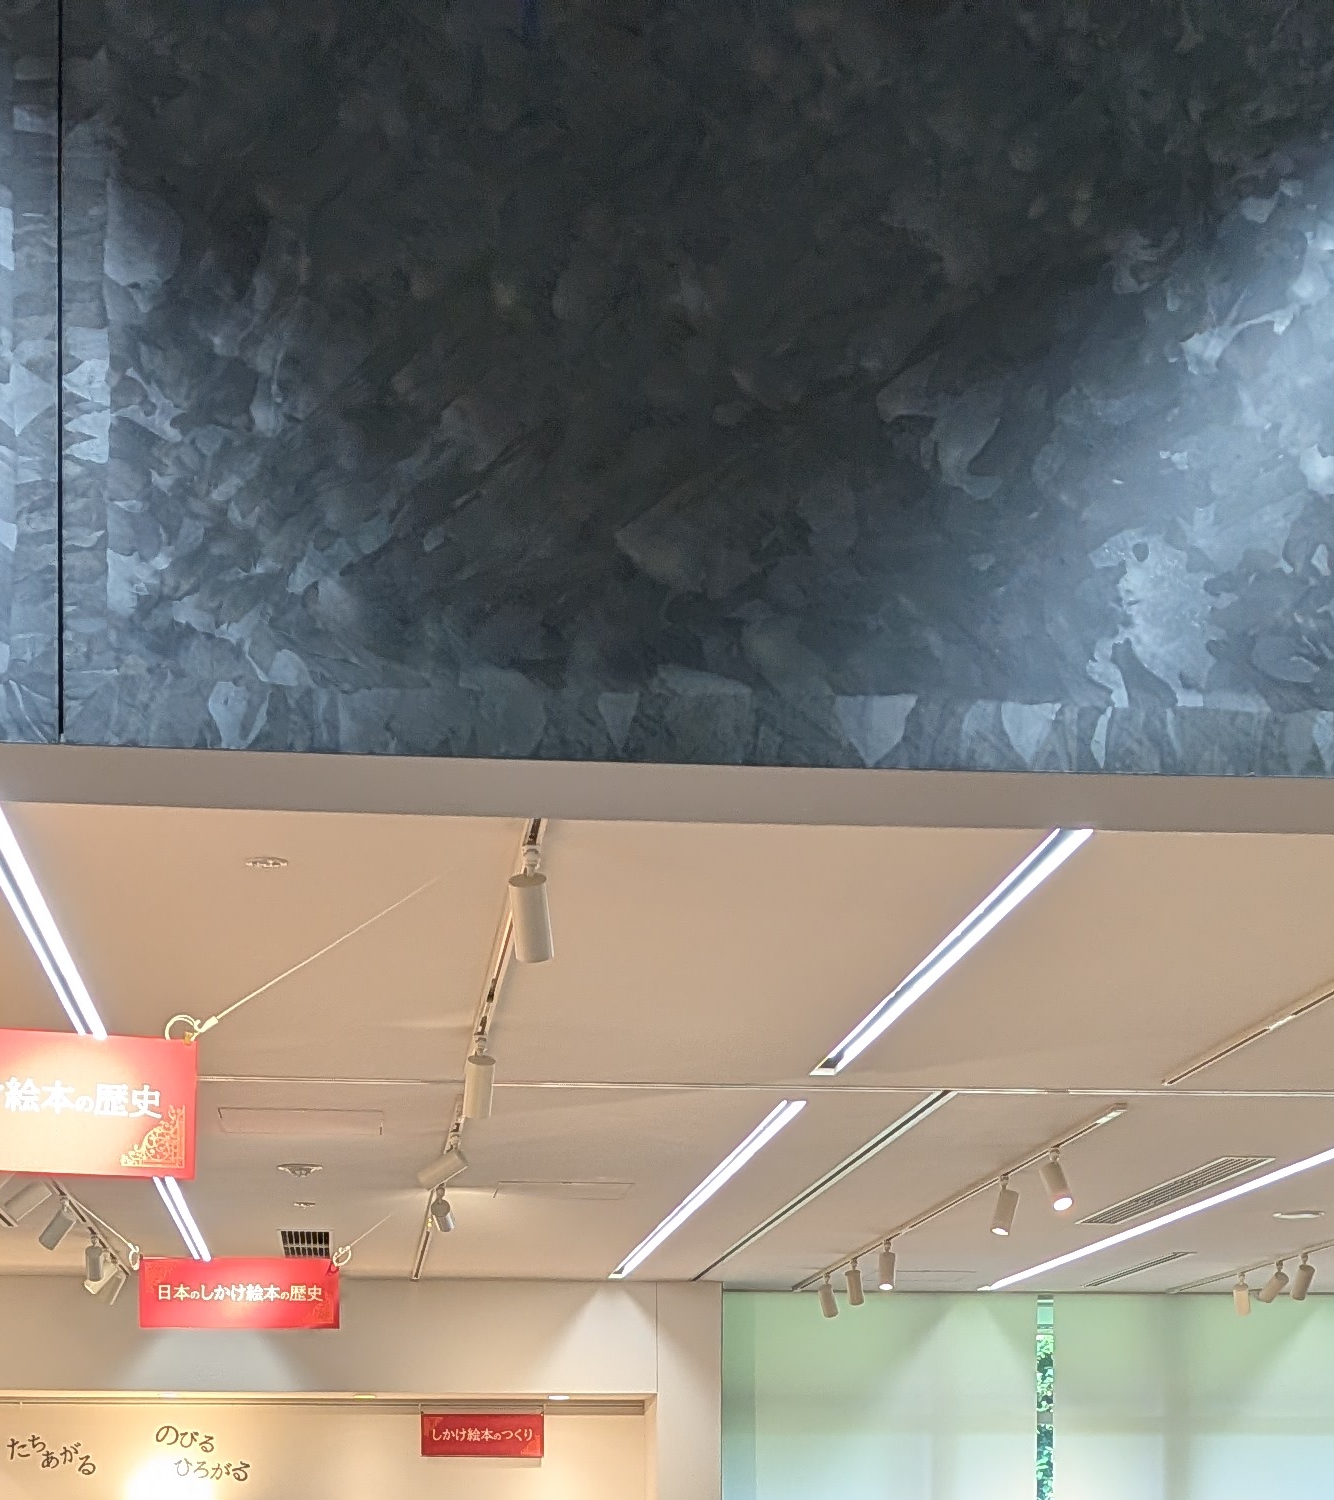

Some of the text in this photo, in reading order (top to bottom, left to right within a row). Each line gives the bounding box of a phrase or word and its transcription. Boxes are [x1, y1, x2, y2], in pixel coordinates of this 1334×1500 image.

[157, 1283, 323, 1303] 日本のしかけ絵本の歴史
[155, 1425, 214, 1452] のびる
[432, 1427, 534, 1443] しかけ絵本のつくり
[7, 1433, 96, 1476] たちあがる
[174, 1458, 251, 1482] ひろがる
